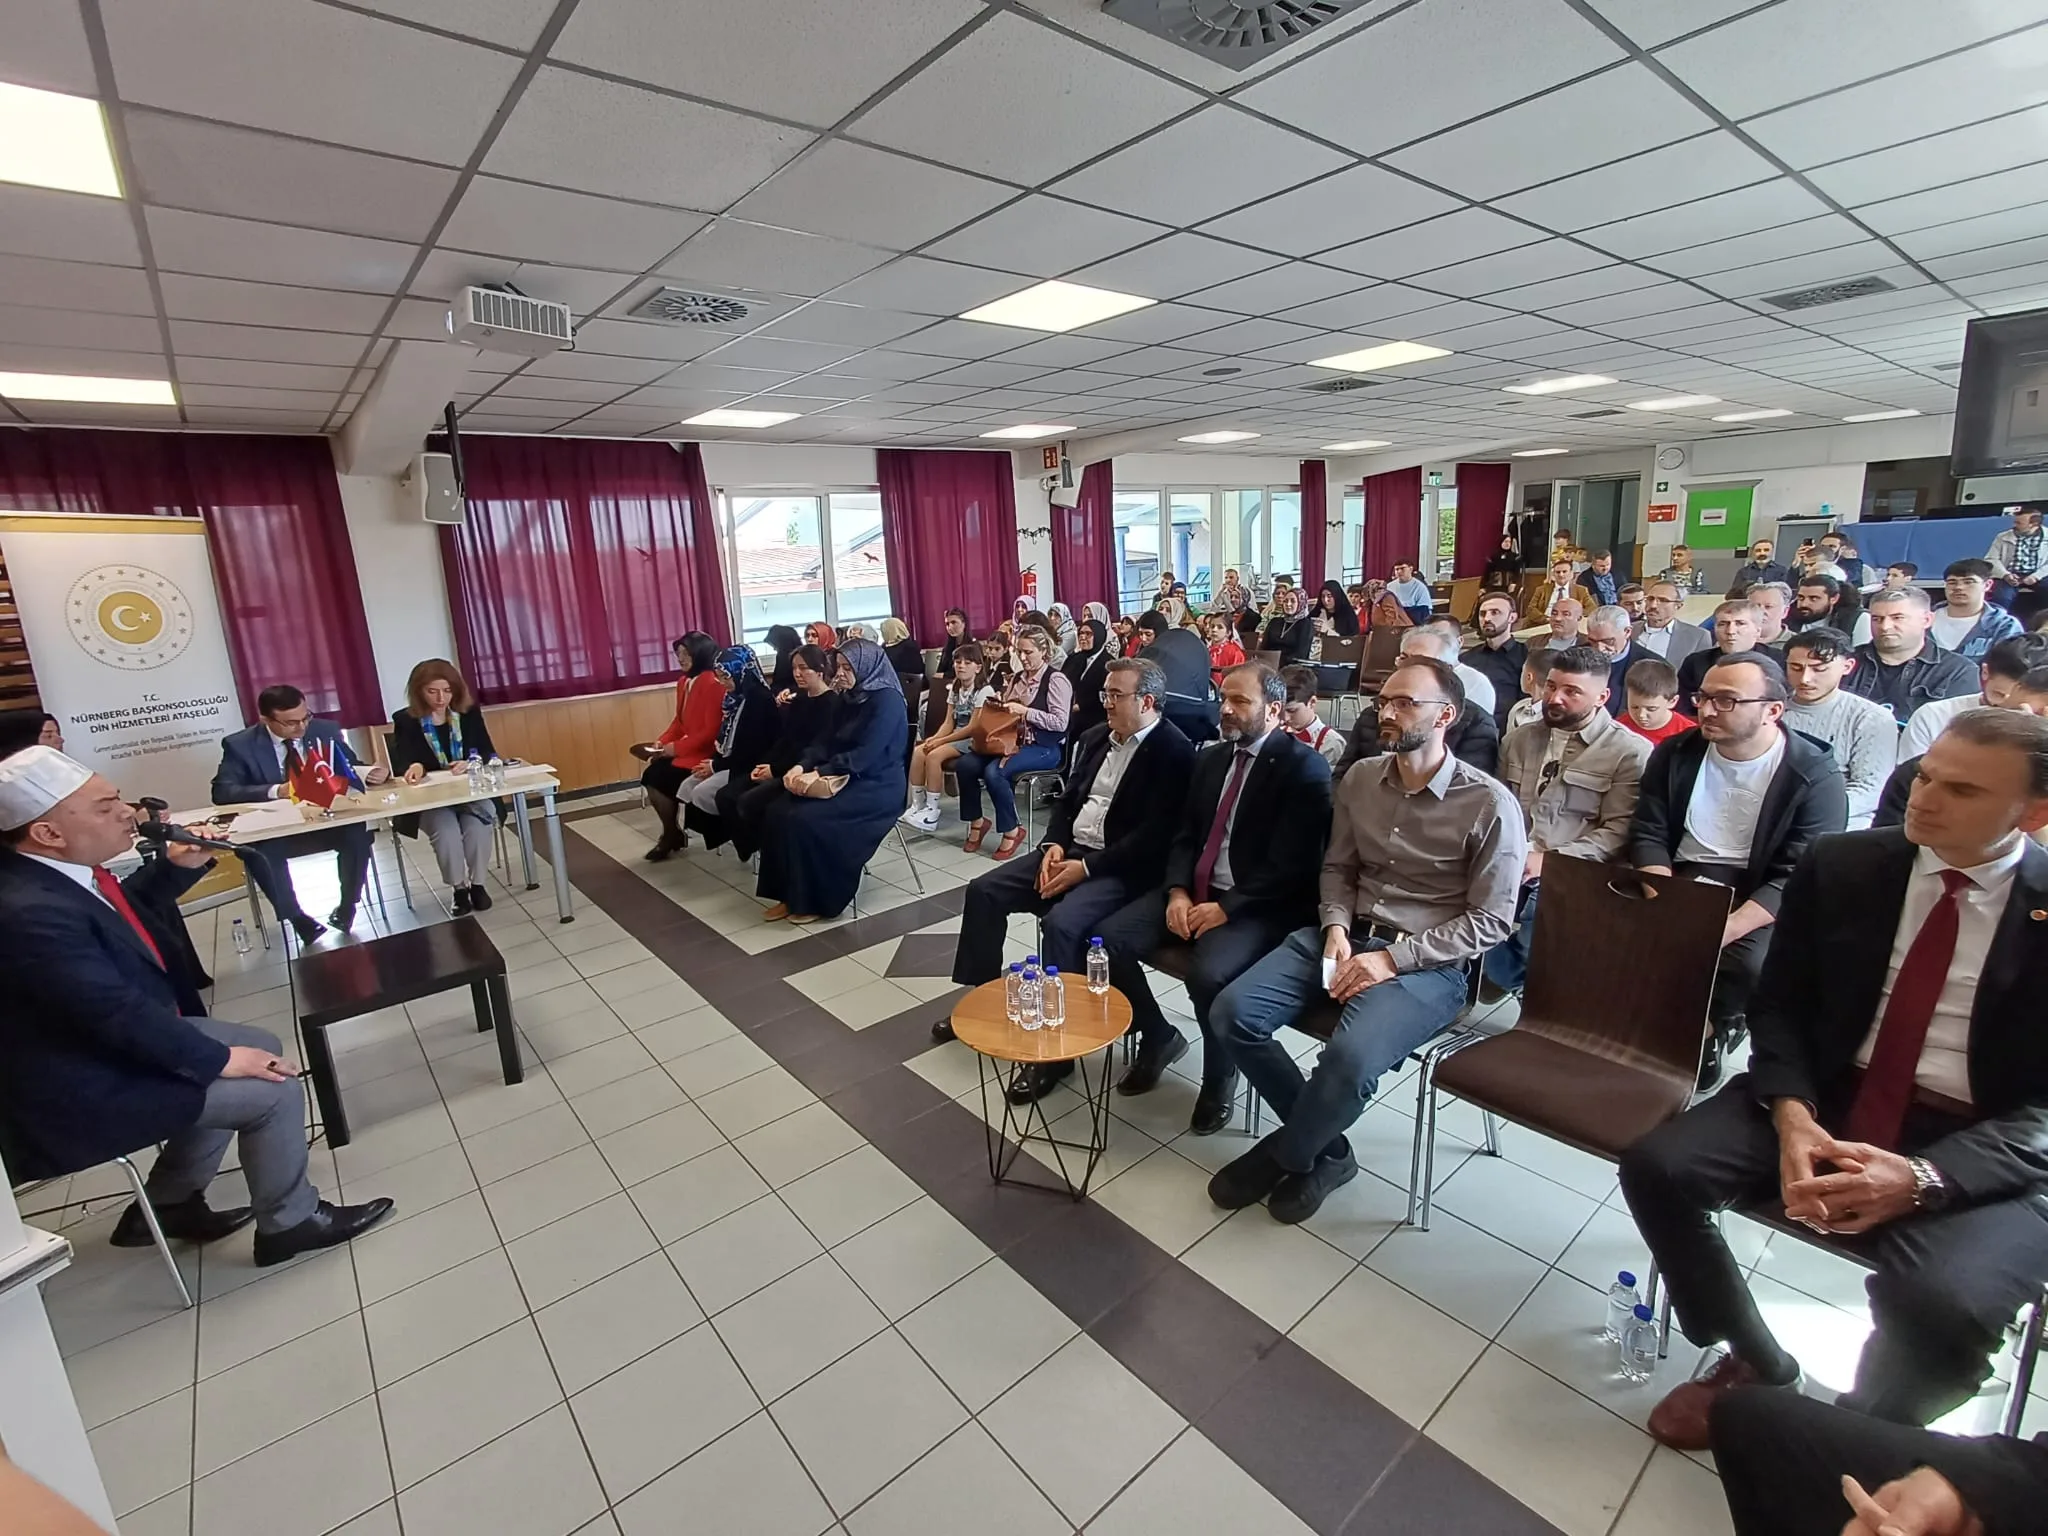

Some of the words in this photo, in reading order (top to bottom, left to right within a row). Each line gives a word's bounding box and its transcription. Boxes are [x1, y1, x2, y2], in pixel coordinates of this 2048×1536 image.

[71, 707, 130, 724] NÜRNBERG
[132, 694, 229, 716] BAŞKONSOLOSLUĞU
[143, 694, 160, 702] T.C.
[90, 723, 110, 734] DİN
[111, 713, 170, 730] HİZMETLERİ
[172, 706, 220, 720] ATAŞELİĞİ
